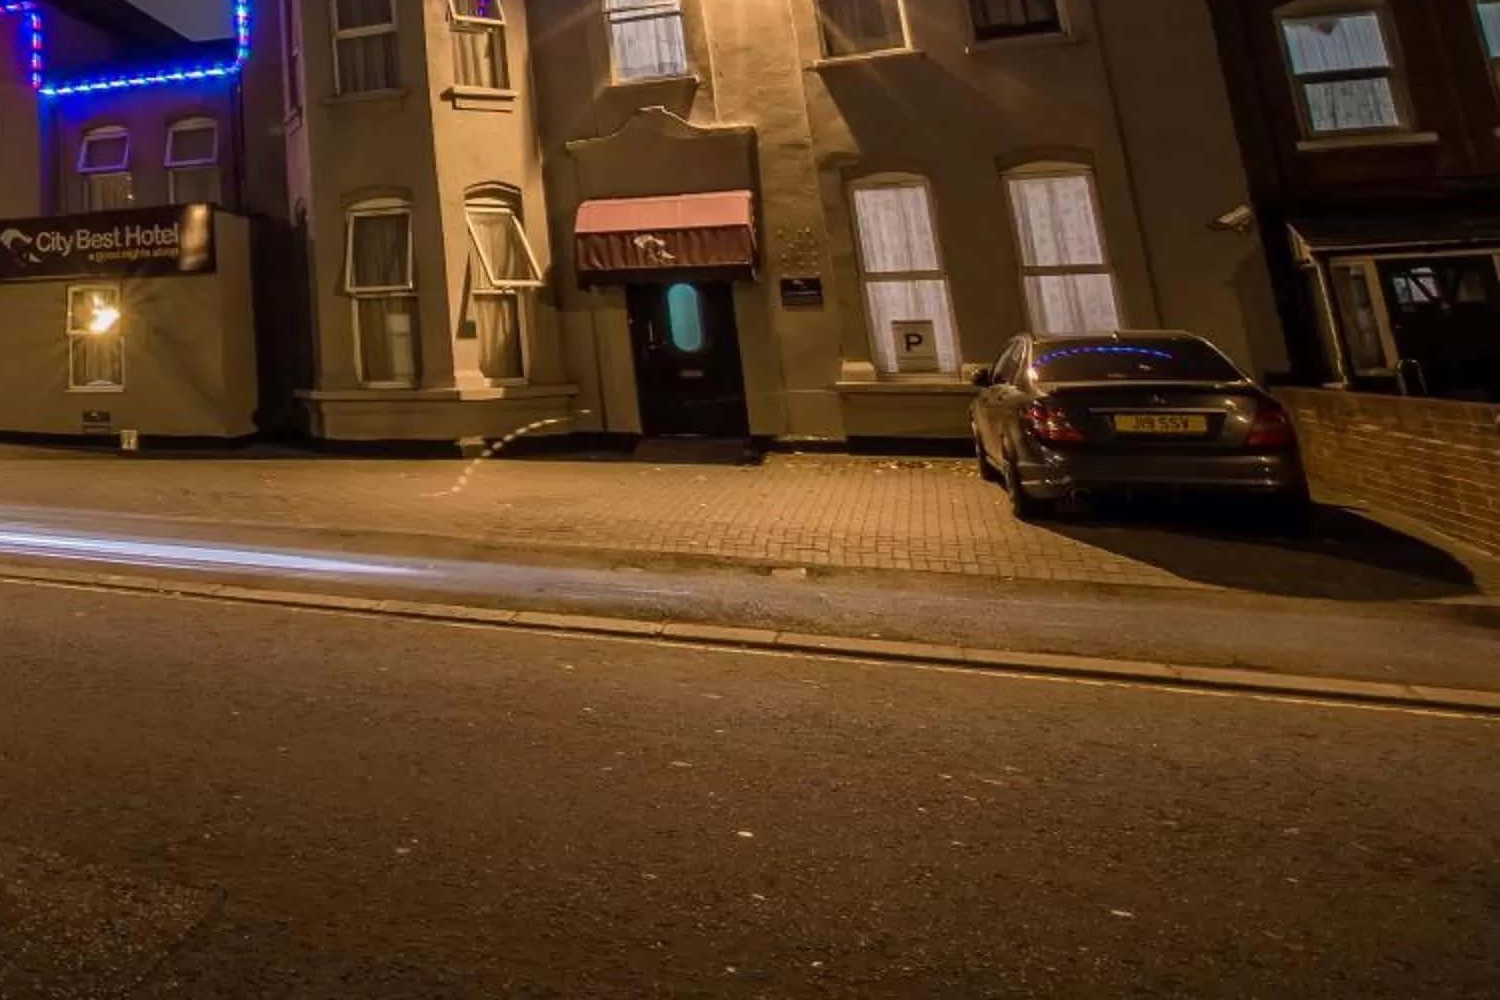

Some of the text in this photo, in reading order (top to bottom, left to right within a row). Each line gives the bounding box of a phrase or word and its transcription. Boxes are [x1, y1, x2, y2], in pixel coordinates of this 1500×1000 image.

[35, 231, 74, 257] City
[75, 225, 121, 249] Best
[125, 221, 179, 247] Hotel
[905, 333, 922, 353] P
